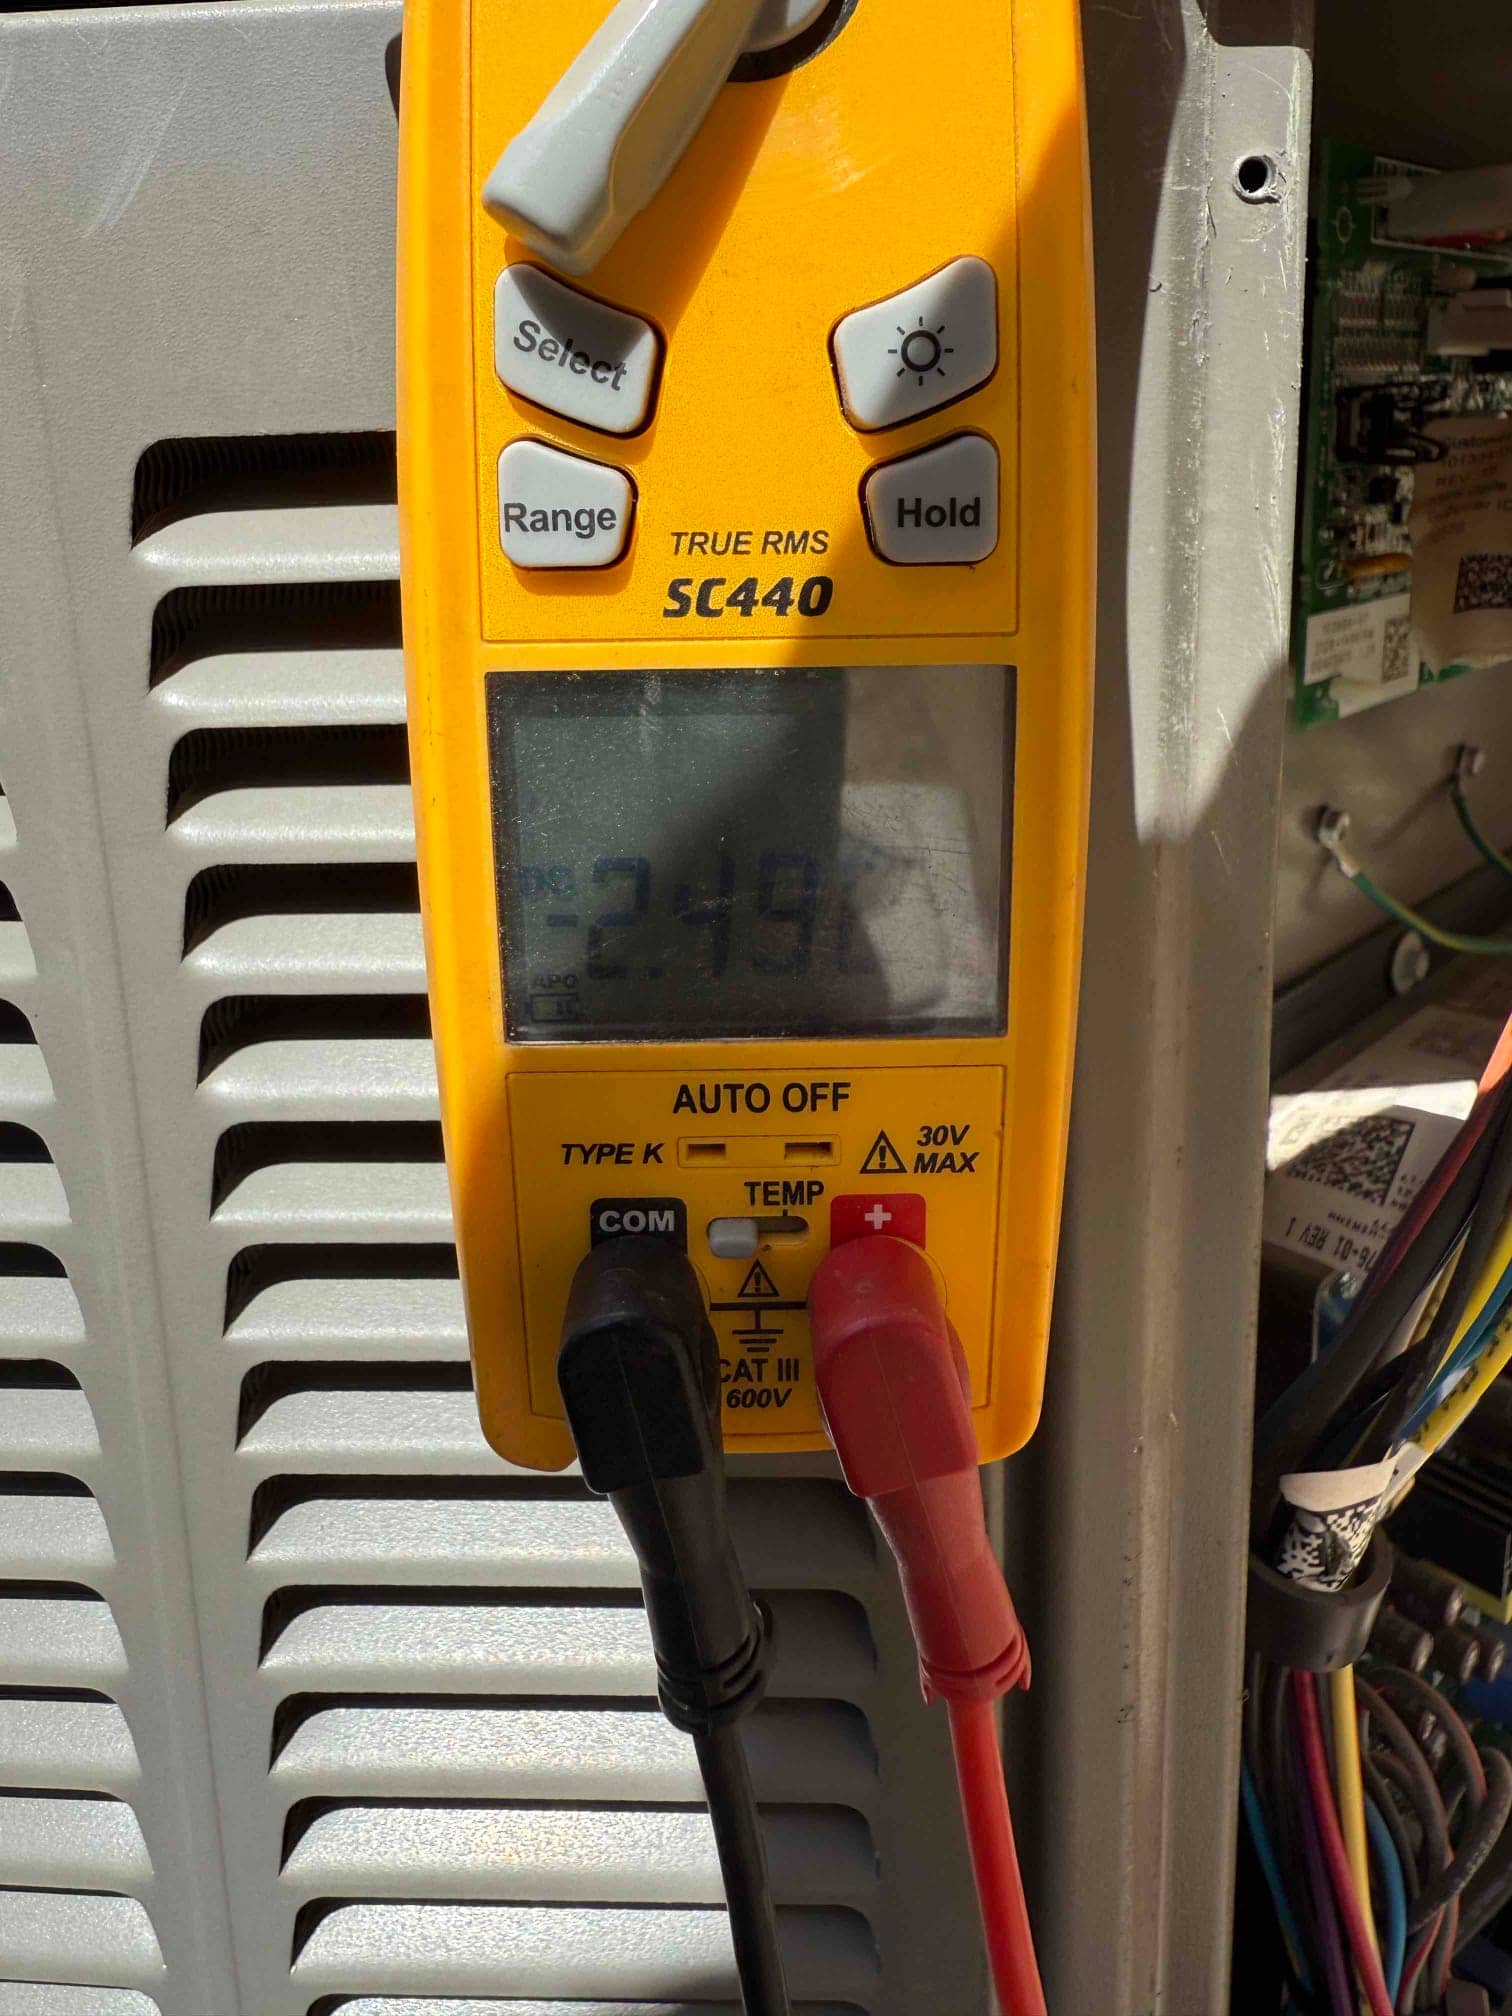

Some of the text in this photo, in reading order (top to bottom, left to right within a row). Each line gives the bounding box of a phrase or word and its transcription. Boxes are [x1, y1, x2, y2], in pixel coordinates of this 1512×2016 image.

[513, 320, 628, 391] Select
[503, 502, 617, 539] Range
[896, 497, 982, 528] Hold
[670, 530, 829, 555] TRUE RMS
[662, 575, 833, 618] SC440
[672, 1081, 851, 1115] AUTO OFF
[916, 1123, 971, 1147] 30V
[560, 1142, 664, 1165] TYPE K
[913, 1151, 980, 1174] MAX
[743, 1180, 825, 1207] TEMP
[599, 1209, 675, 1233] COM
[719, 1358, 800, 1382] CAT III
[726, 1388, 793, 1408] 600V
